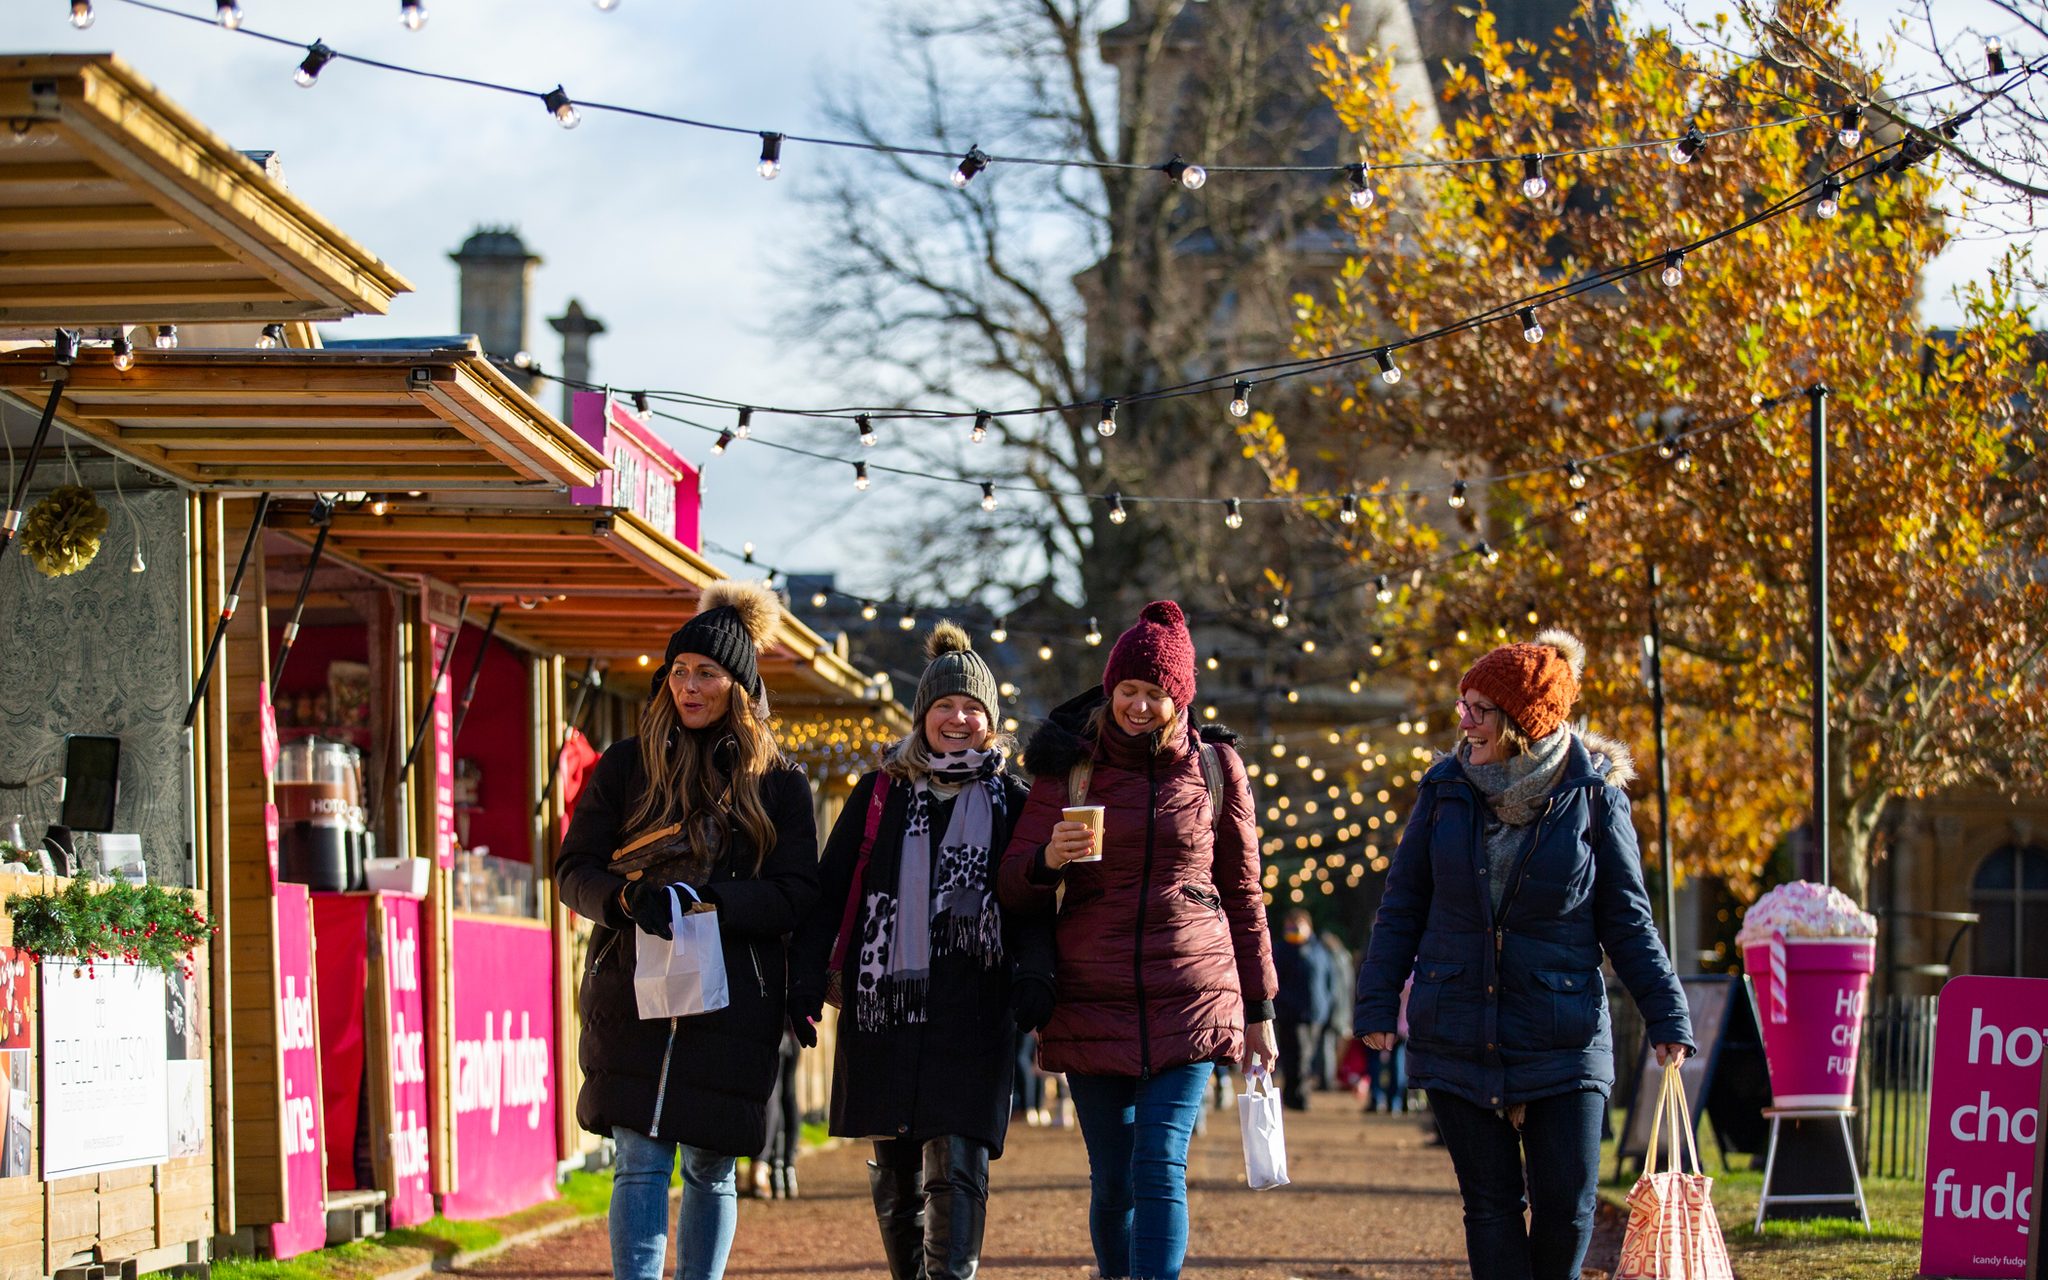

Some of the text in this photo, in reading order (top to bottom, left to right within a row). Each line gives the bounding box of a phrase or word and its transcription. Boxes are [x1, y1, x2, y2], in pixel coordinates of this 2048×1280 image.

[391, 917, 416, 991] hot
[282, 975, 313, 1050] ulled
[1835, 988, 1863, 1018] HO
[1831, 1024, 1860, 1047] CHO
[1968, 1007, 2048, 1067] ho
[502, 1009, 548, 1130] fudge
[1827, 1055, 1856, 1076] FUD
[1950, 1091, 2038, 1144] cho
[1932, 1168, 2032, 1234] fudg
[1973, 1255, 2001, 1267] icandy
